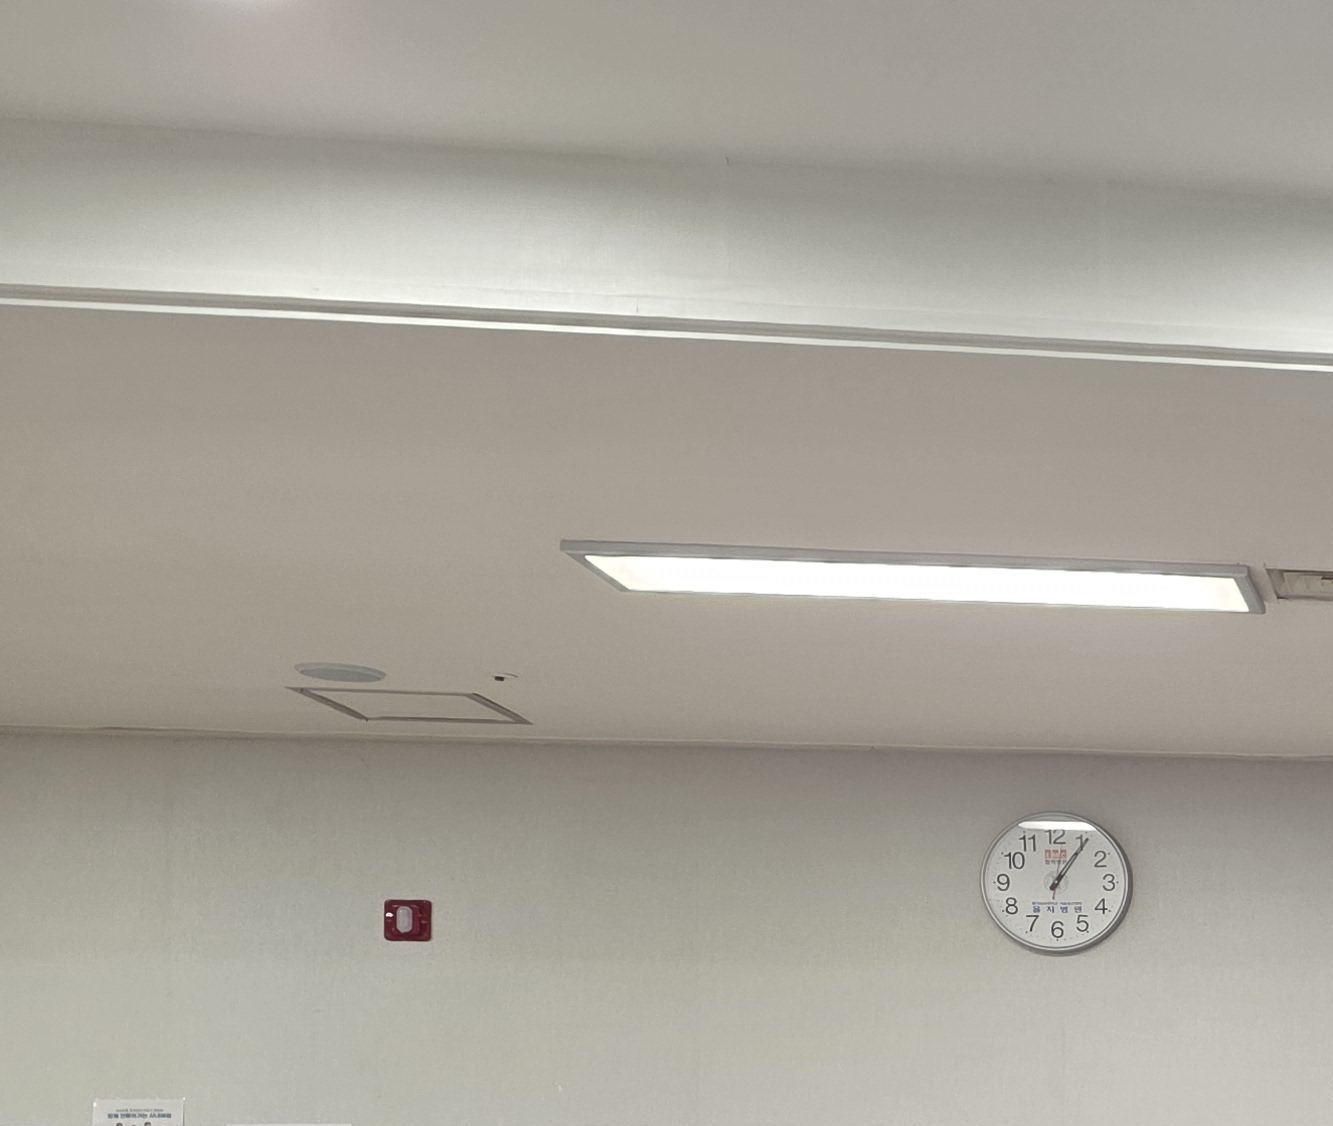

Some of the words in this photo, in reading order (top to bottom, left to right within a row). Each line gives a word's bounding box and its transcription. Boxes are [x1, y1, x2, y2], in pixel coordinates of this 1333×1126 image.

[1018, 834, 1037, 852] 11
[1044, 829, 1066, 845] 12
[1075, 834, 1084, 851] 1
[1004, 851, 1025, 869] 10
[1094, 850, 1107, 868] 2
[997, 874, 1010, 891] 9
[1102, 874, 1116, 891] 3
[1005, 897, 1018, 915] 8
[1094, 898, 1108, 915] 4
[1026, 915, 1039, 932] 7
[1051, 921, 1064, 938] 6
[1076, 915, 1089, 932] 5
